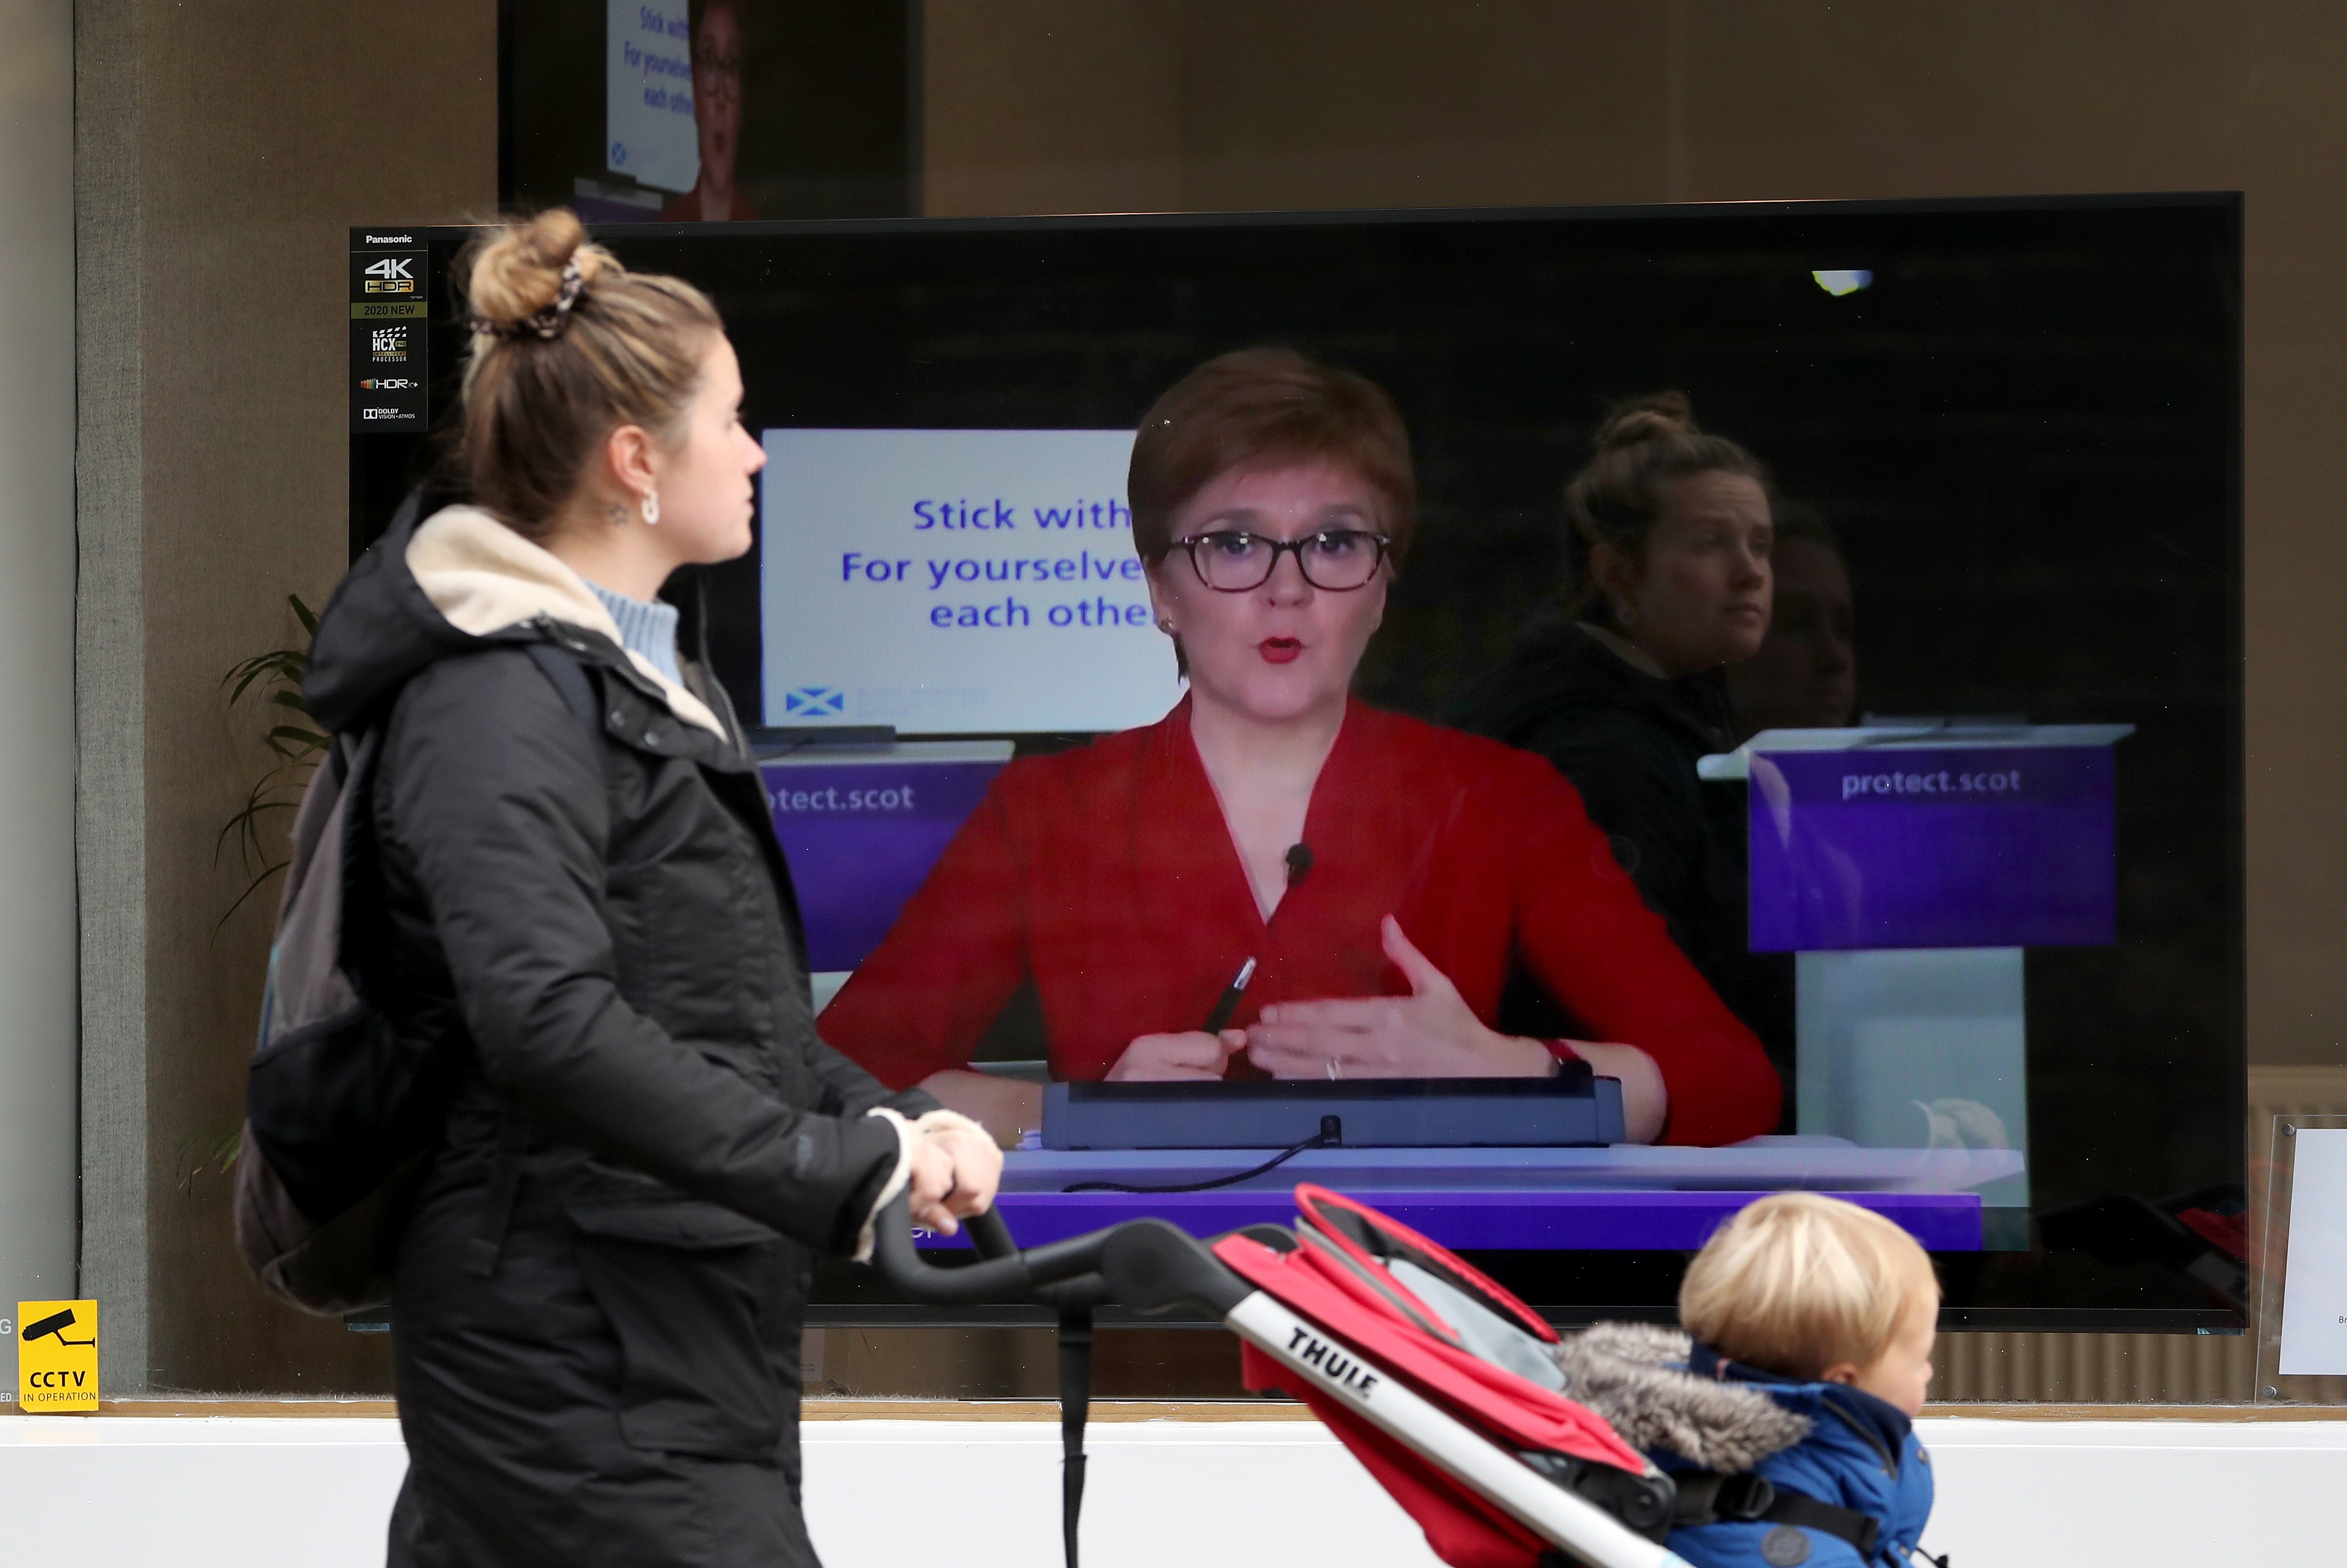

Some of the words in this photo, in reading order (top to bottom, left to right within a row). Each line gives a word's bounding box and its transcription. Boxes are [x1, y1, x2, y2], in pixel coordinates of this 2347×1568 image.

[366, 235, 412, 243] Panasonic
[365, 258, 414, 278] 4K
[367, 281, 411, 291] HDR
[364, 306, 388, 315] 2020
[391, 305, 415, 314] NEW
[372, 338, 396, 351] HCX
[913, 499, 1015, 530] Stick
[1033, 498, 1132, 530] with
[842, 553, 912, 582] For
[930, 597, 1030, 628] each
[1841, 769, 2021, 801] protect.scot
[1288, 1327, 1378, 1399] THULE
[30, 1371, 86, 1388] CCTV
[0, 1392, 12, 1402] ED
[24, 1393, 34, 1402] IN
[38, 1392, 96, 1402] OPERATION
